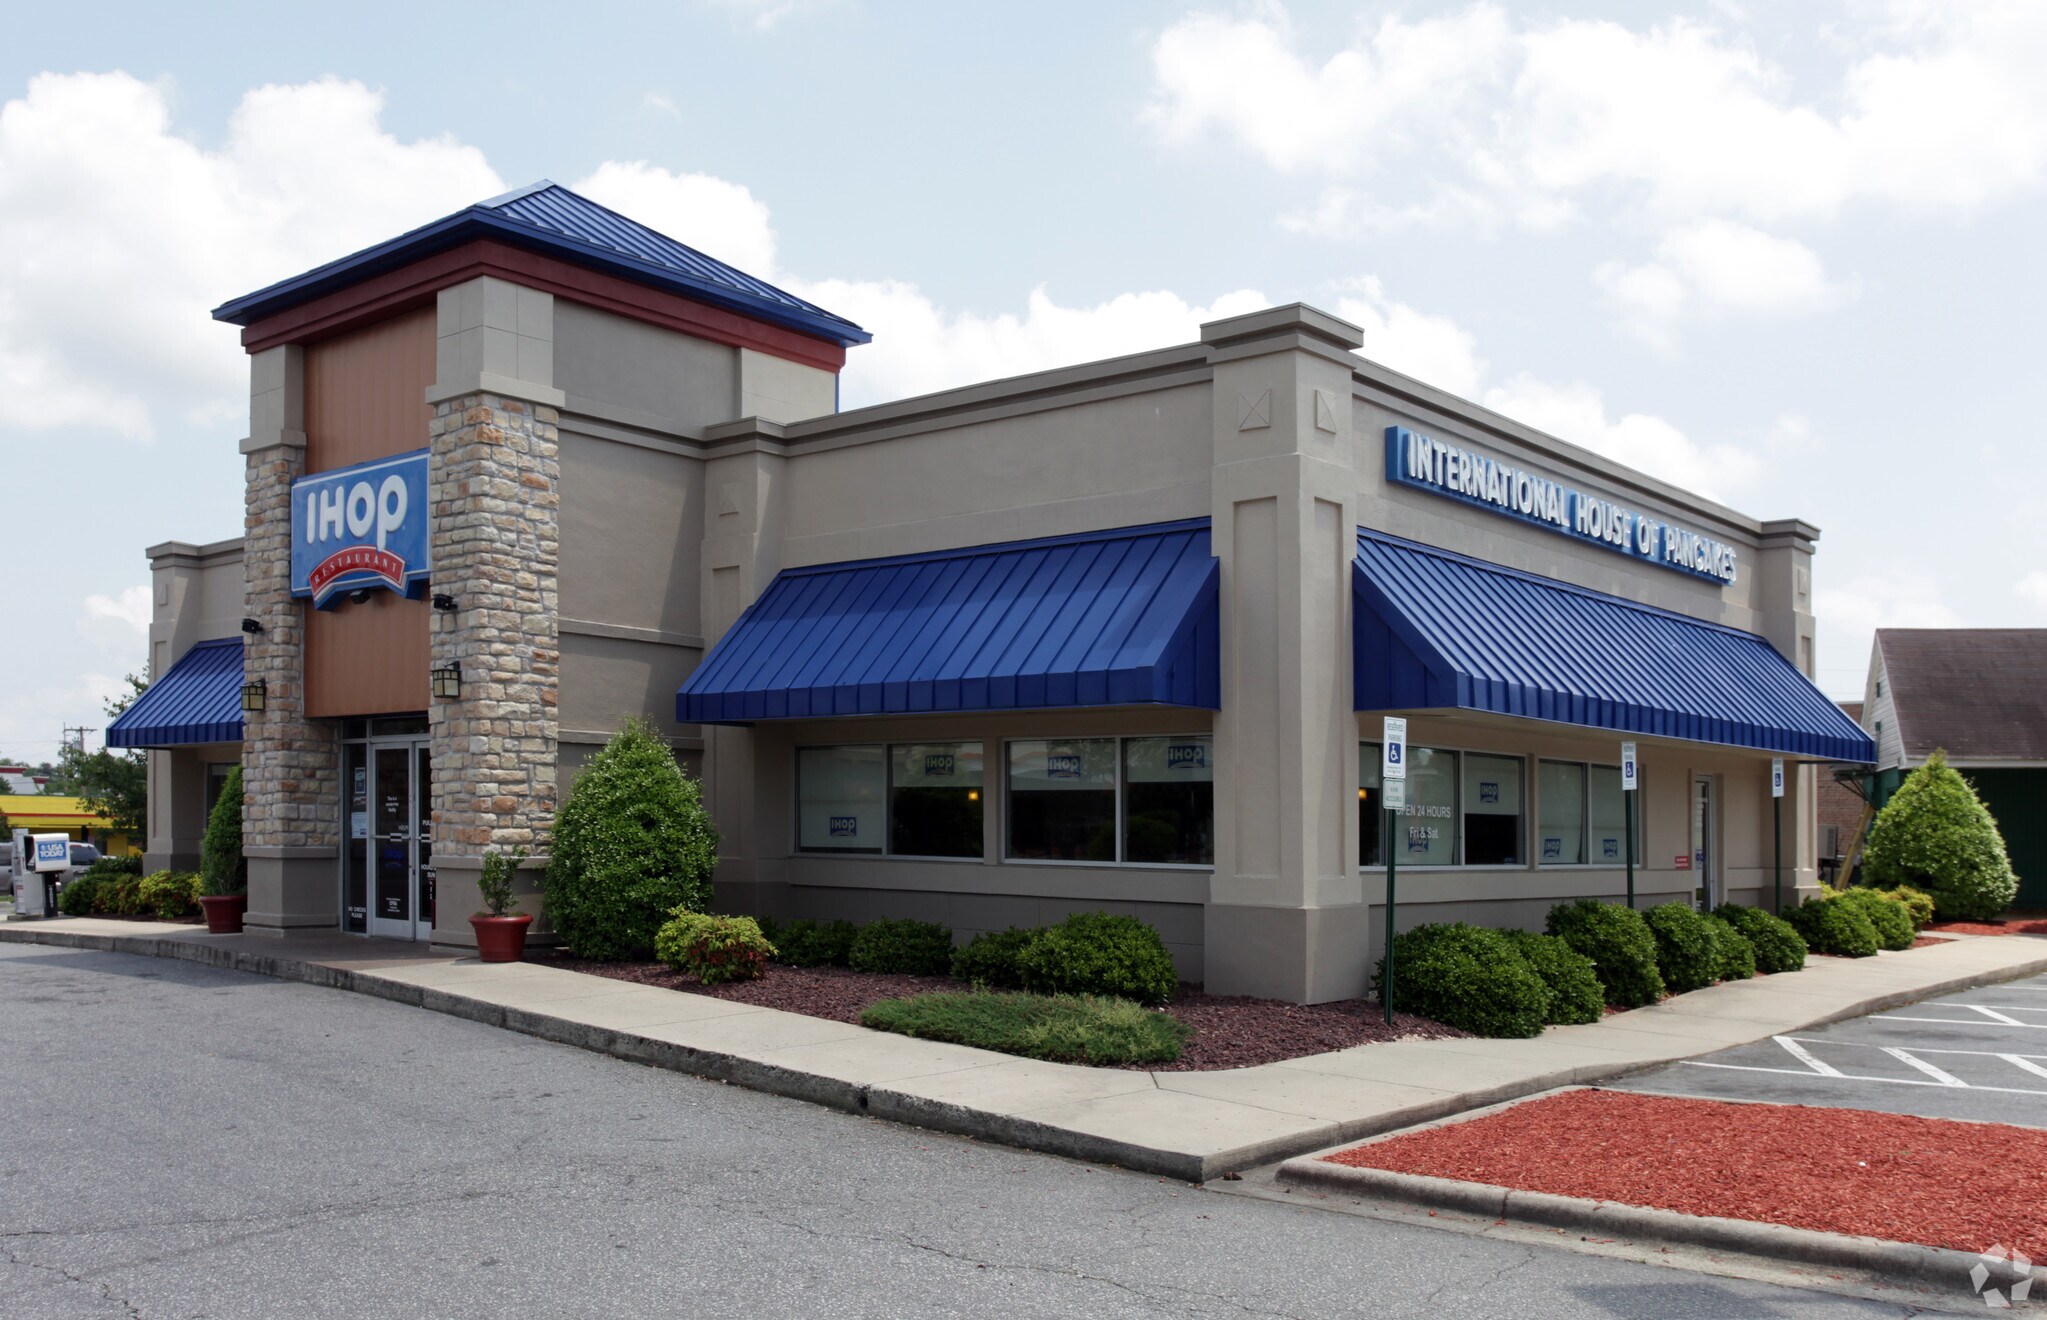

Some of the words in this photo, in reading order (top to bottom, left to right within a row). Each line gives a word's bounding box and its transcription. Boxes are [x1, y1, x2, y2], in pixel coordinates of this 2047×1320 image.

[1407, 430, 1570, 527] INTERNATIONAL
[1575, 491, 1632, 548] HOUSE
[1636, 514, 1660, 556] OF
[1664, 524, 1737, 582] PANCAKES
[306, 474, 408, 552] IHOP
[313, 551, 398, 584] RESTAURANT
[1169, 747, 1203, 764] IHOP
[1050, 758, 1079, 772] IHOP
[1417, 805, 1425, 817] 24
[1426, 805, 1451, 818] HOURS
[831, 819, 855, 832] IHOP
[1409, 826, 1419, 838] Fri
[1420, 827, 1426, 839] &
[1427, 827, 1439, 839] Sat
[47, 843, 64, 851] USA
[40, 850, 64, 858] TODAY
